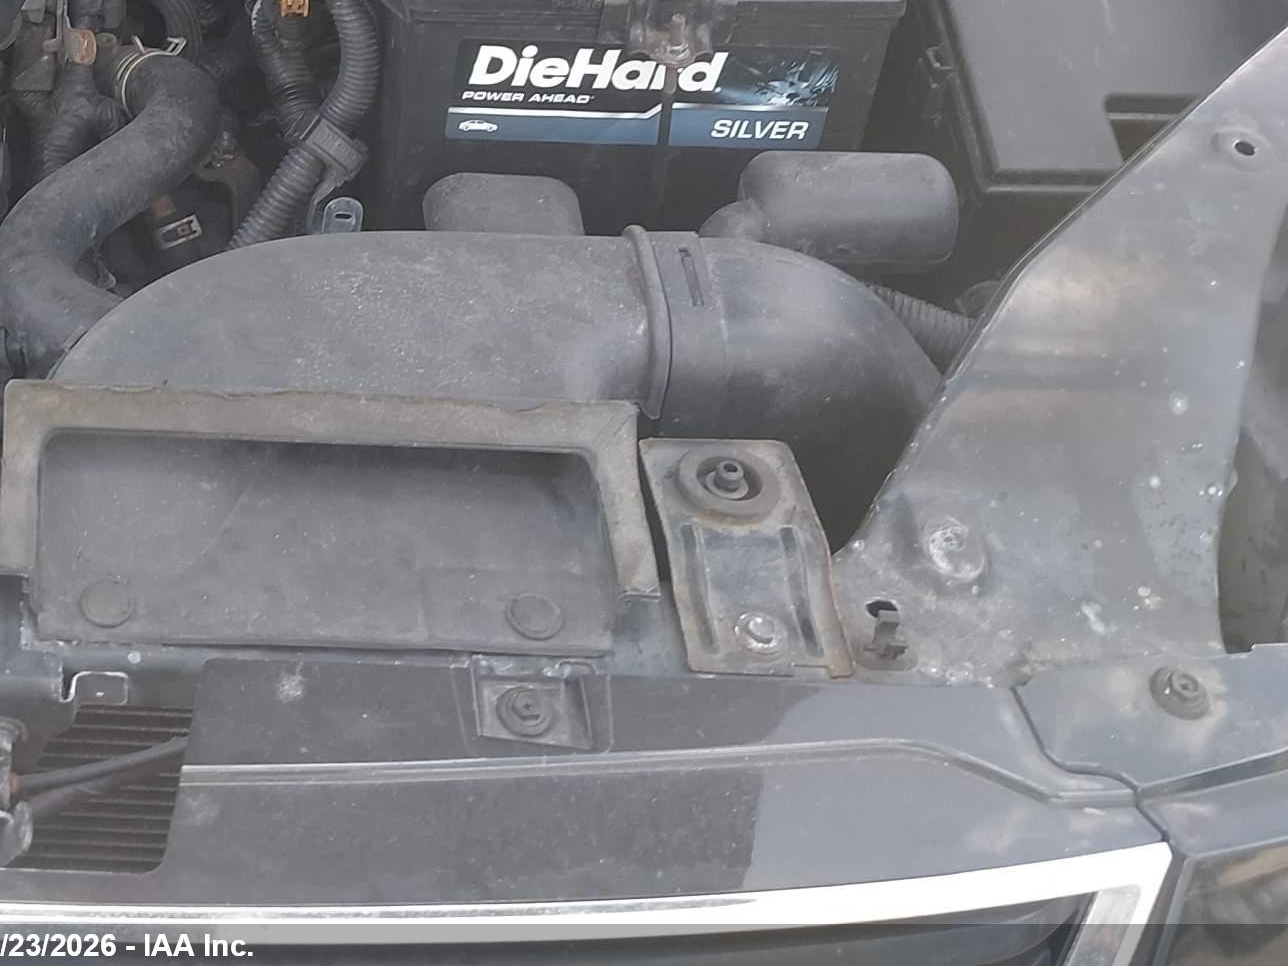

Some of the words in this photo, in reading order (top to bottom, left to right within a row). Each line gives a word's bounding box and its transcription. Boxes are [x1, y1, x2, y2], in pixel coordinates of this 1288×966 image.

[461, 90, 525, 102] POWER
[528, 93, 592, 104] AHEAD
[711, 119, 809, 140] SILVER
